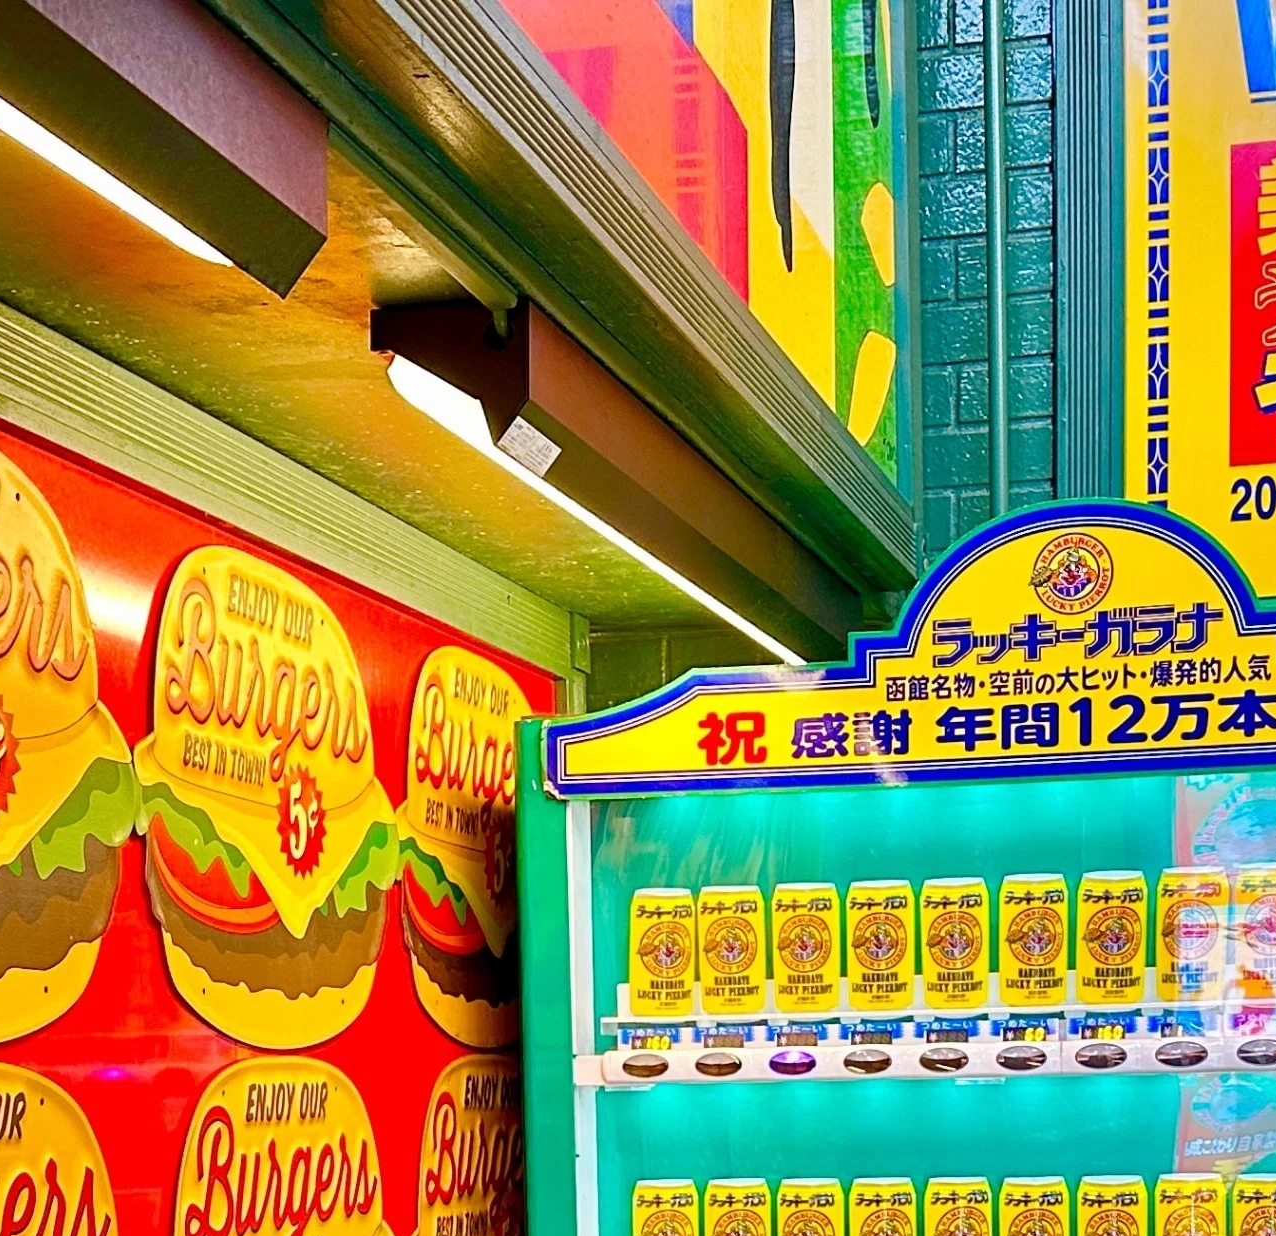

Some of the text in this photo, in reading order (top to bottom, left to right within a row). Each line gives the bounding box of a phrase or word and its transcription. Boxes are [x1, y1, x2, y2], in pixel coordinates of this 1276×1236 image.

[1041, 536, 1105, 565] HAMBURGER
[1041, 567, 1110, 611] LUCKY PIERROT
[933, 603, 1223, 668] ラッキーガラナ
[697, 711, 768, 766] 祝
[791, 707, 912, 758] 感謝
[245, 1081, 328, 1123] ENJOY OUR
